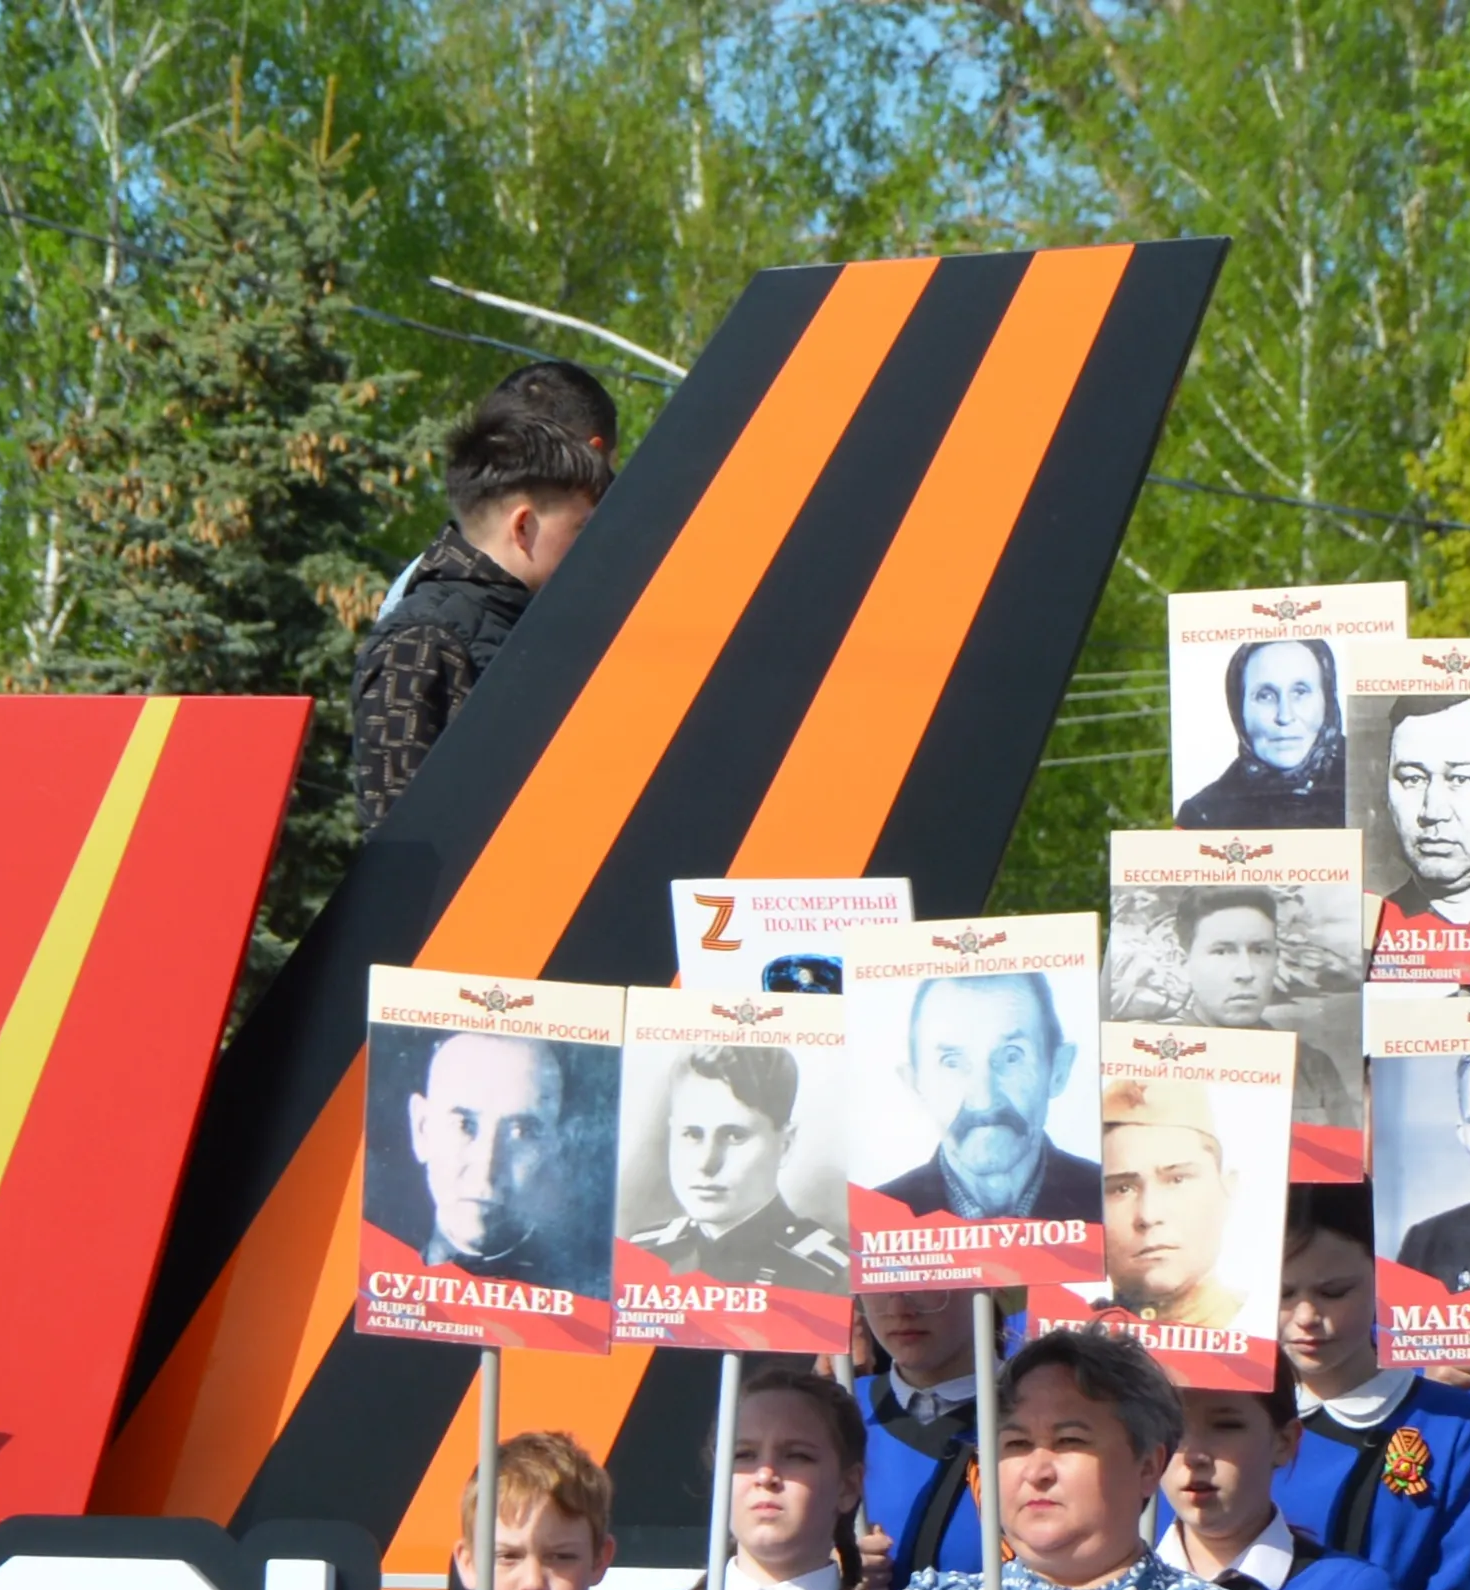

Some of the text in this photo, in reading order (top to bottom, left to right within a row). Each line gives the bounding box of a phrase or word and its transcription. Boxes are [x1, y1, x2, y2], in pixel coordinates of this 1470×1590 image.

[1182, 620, 1395, 643] БЕССМЕРТНЫЙ ПОЛК РОССИИ
[1356, 677, 1454, 692] БЕССМЕРТНЫЙ
[1124, 867, 1349, 882] БЕССМЕРТНЫЙ ПОЛК РОССИИ
[751, 893, 898, 912] БЕССМЕРТНЫЙ
[764, 916, 818, 932] ПОЛК
[855, 953, 1085, 980] БЕССМЕРТНЫЙ ПОЛК РОССИИ
[381, 1006, 610, 1041] БЕССМЕРТНЫЙ ПОЛК РОССИИ
[636, 1026, 746, 1043] БЕССМЕРТНЫЙ
[750, 1030, 791, 1044] ПОЛК
[1173, 1067, 1215, 1081] ПОЛК
[1220, 1069, 1281, 1085] РОССИИ
[861, 1219, 1087, 1255] МИНЛИГУЛОВ
[862, 1267, 983, 1284] МИНЛИГУЛОВИЧ
[368, 1270, 574, 1316] СУЛТАНАЕВ
[617, 1283, 767, 1314] ЛАЗАРЕВ
[367, 1300, 426, 1317] АНДРЕЙ
[615, 1310, 685, 1325] ДМИТРИЙ
[366, 1316, 484, 1337] АСЫЛГАРЕЕВИЧ
